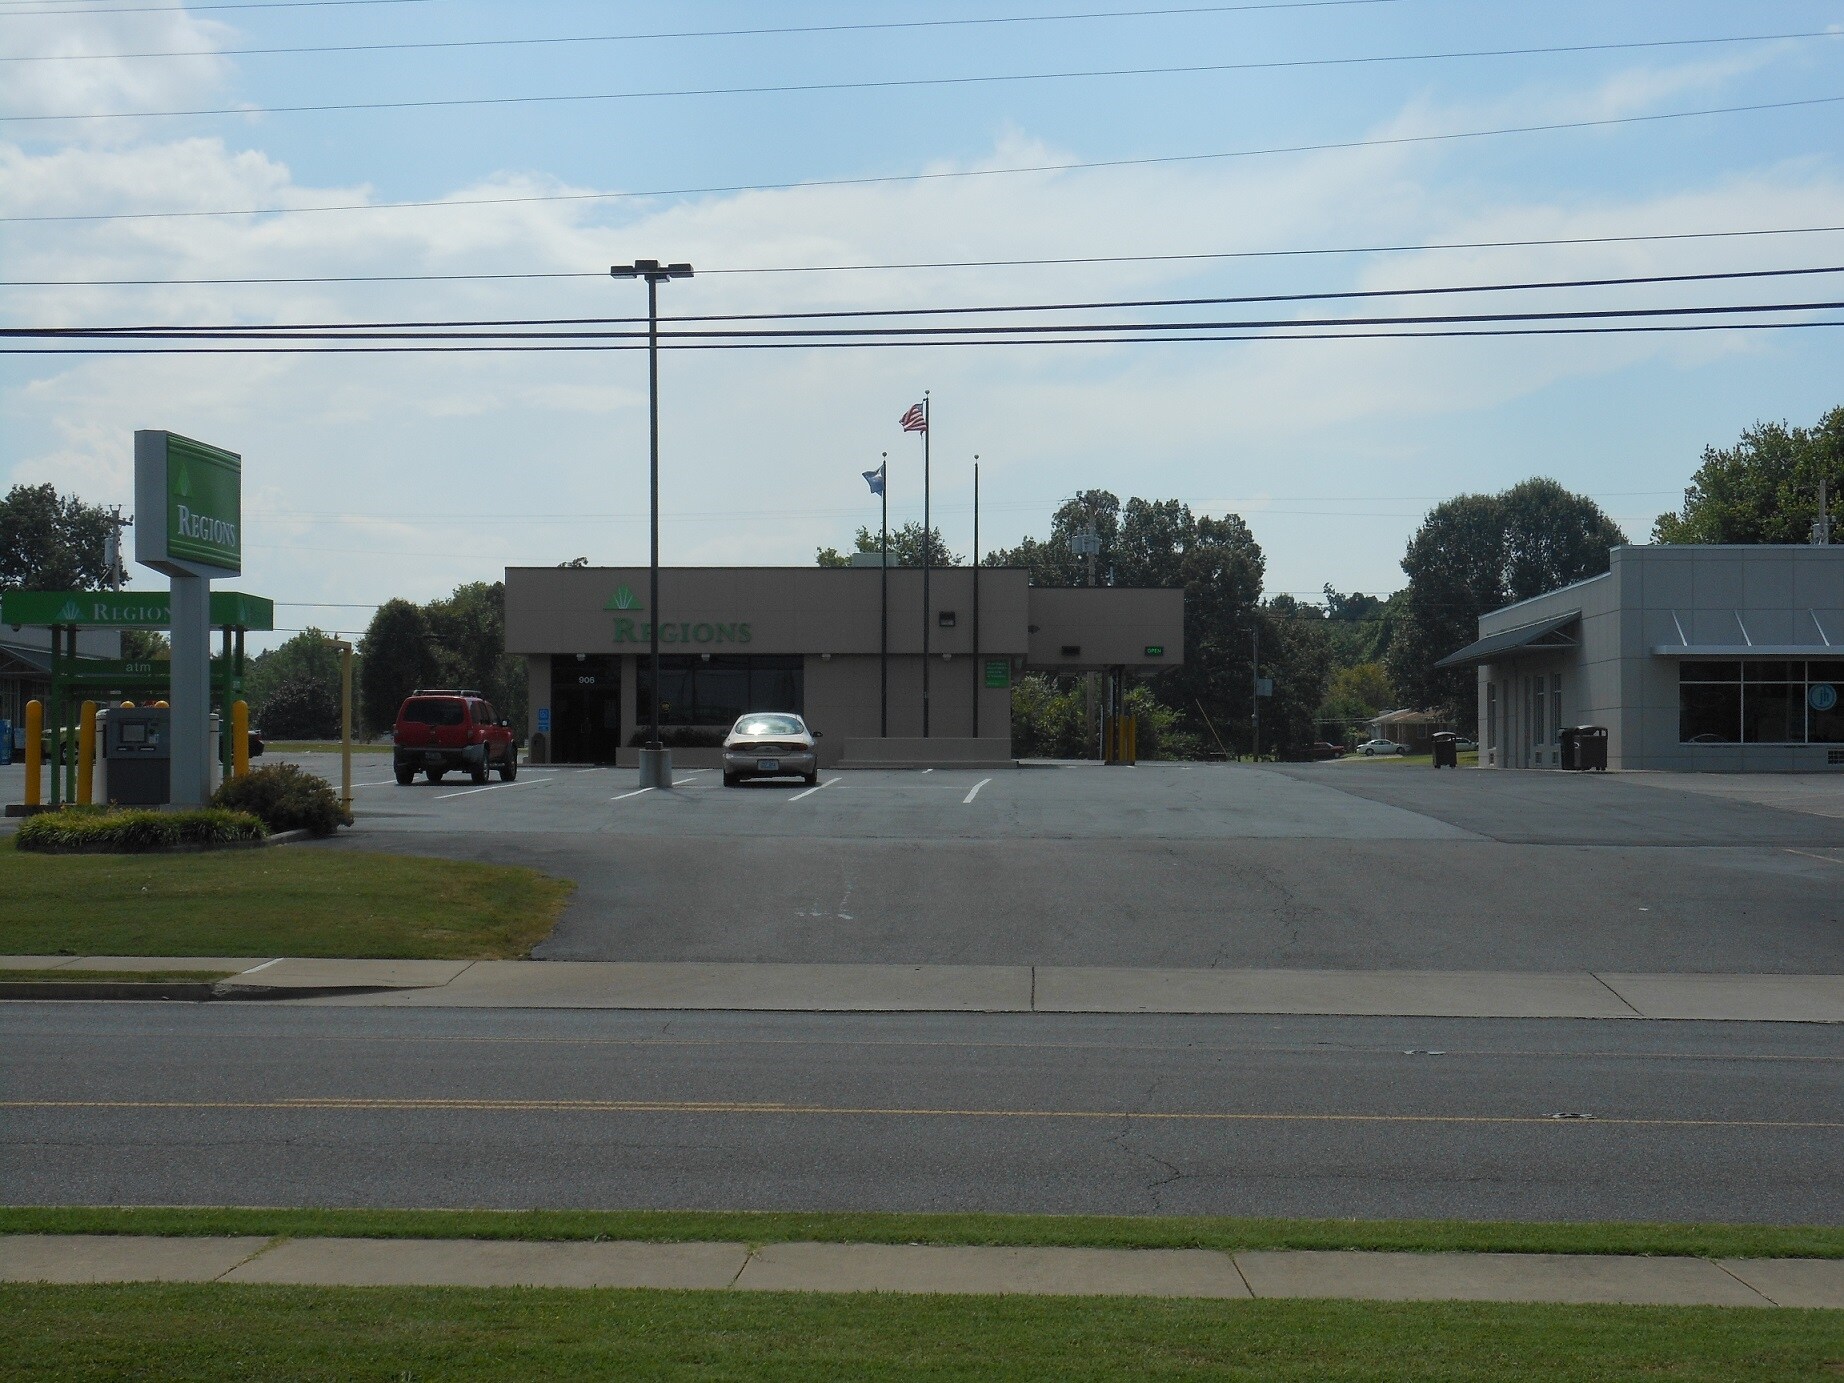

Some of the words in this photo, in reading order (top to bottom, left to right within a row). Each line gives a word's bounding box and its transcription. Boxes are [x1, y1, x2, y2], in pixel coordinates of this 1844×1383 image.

[178, 504, 235, 547] REGIONS
[93, 603, 171, 620] REGION
[613, 617, 752, 643] REGIONS
[126, 663, 151, 672] atm
[579, 676, 595, 684] 906
